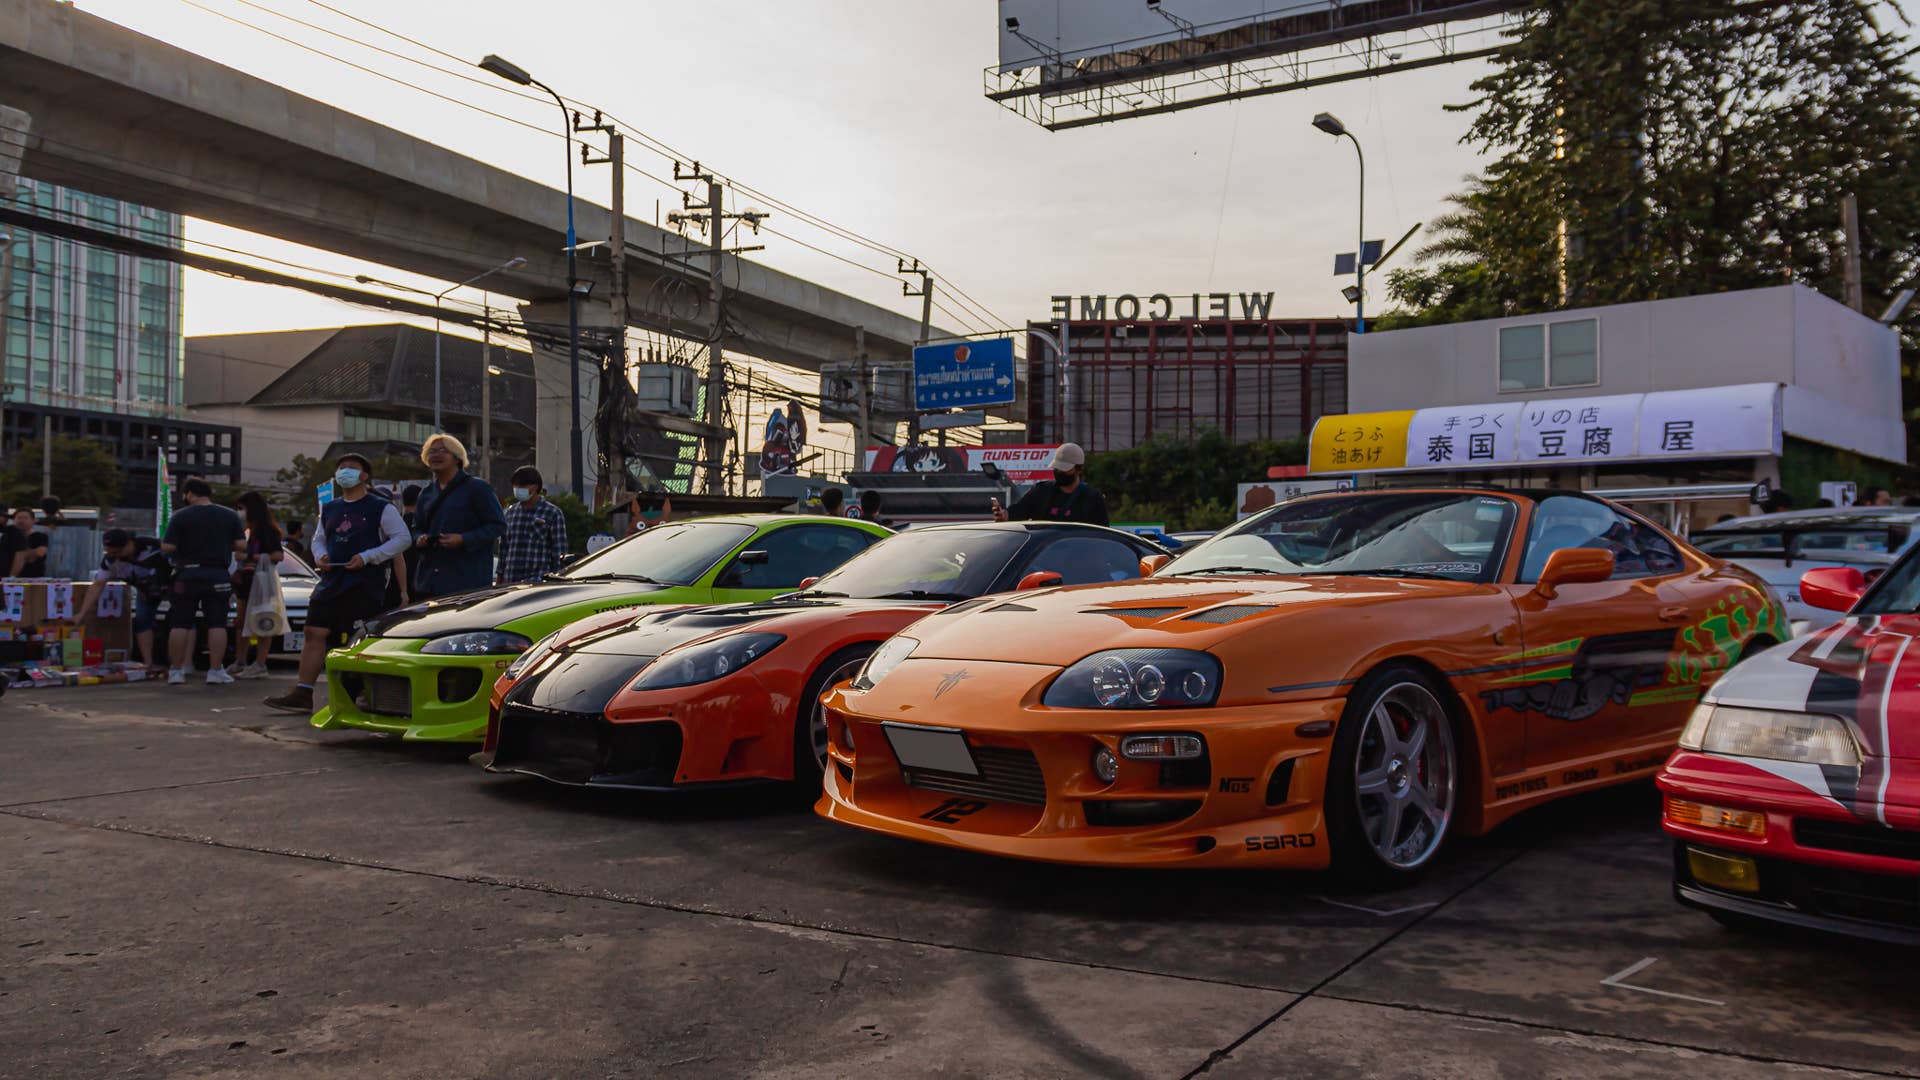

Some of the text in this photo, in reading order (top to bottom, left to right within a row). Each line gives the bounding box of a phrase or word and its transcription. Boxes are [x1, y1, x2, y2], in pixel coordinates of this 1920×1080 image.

[1444, 405, 1600, 431] 手づくりの店
[1333, 426, 1384, 443] とうふ
[1427, 420, 1694, 463] 泰国豆腐屋
[983, 450, 1050, 461] RUNSTOP
[1332, 446, 1384, 464] 油あげ
[919, 797, 989, 825] 12
